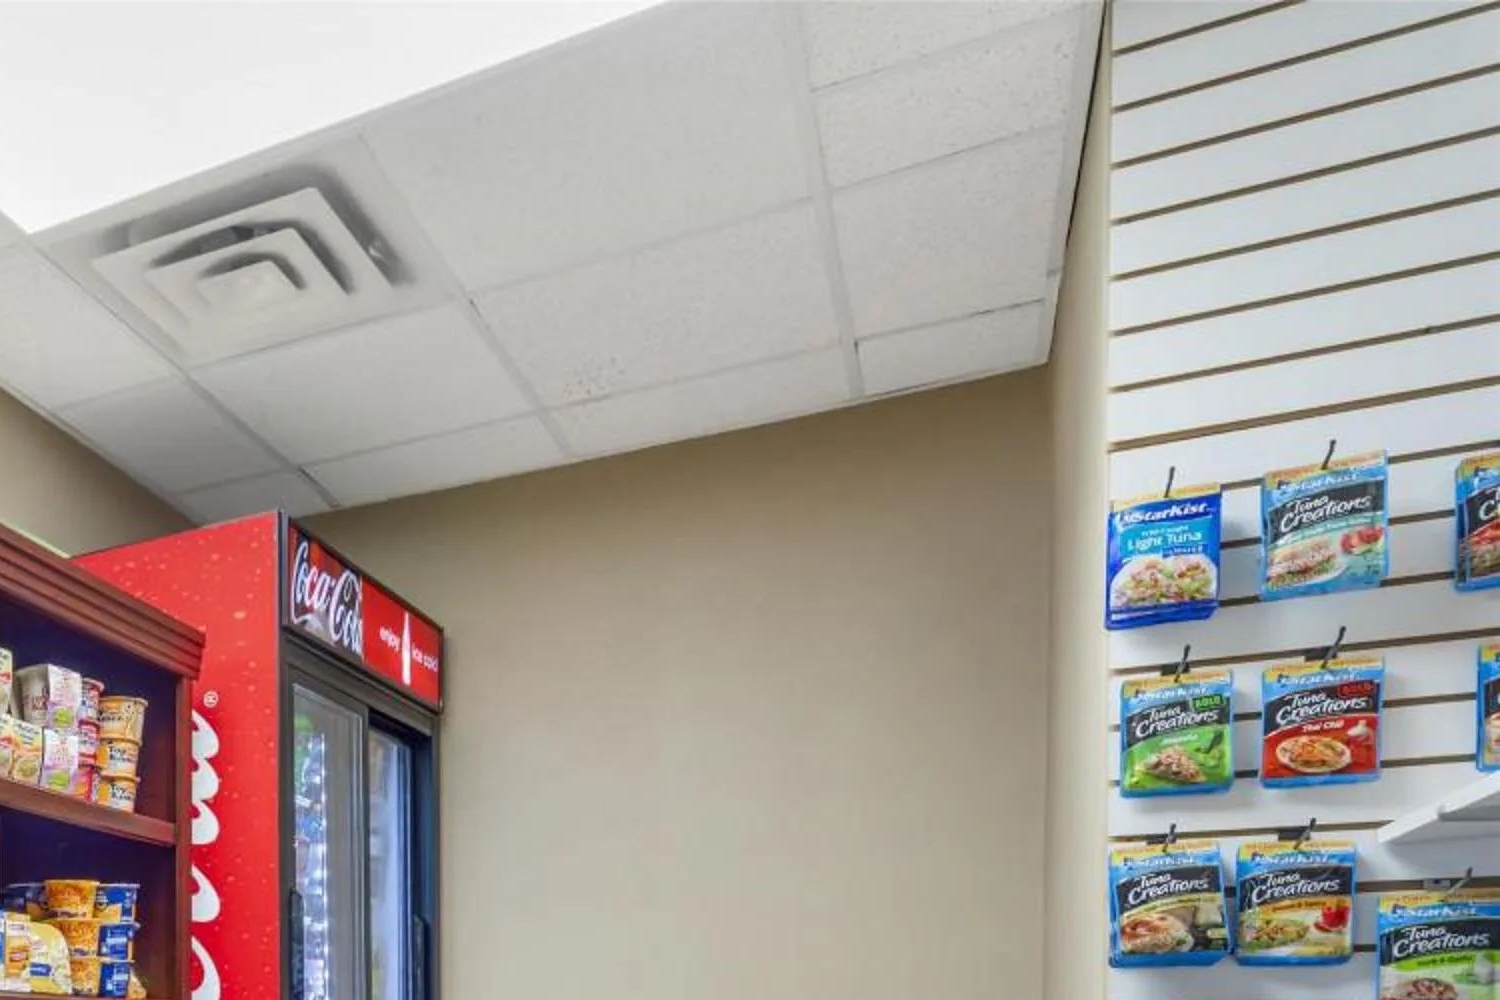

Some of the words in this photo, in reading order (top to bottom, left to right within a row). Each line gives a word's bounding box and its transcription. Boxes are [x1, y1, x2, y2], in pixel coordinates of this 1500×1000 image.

[1280, 496, 1372, 533] Creations
[1286, 496, 1329, 513] Tuna
[1127, 535, 1163, 551] Light
[1167, 530, 1202, 544] Tuna
[1284, 691, 1327, 708] Tuna
[1142, 706, 1181, 721] Tuna
[1275, 697, 1370, 725] Creations
[1135, 709, 1220, 738] Creations
[1134, 873, 1172, 889] Tuna
[1259, 871, 1301, 888] Tuna
[1127, 877, 1209, 905] Creations
[1251, 879, 1341, 904] Creations
[1401, 925, 1447, 941] Tuna
[1393, 934, 1491, 958] Creations
